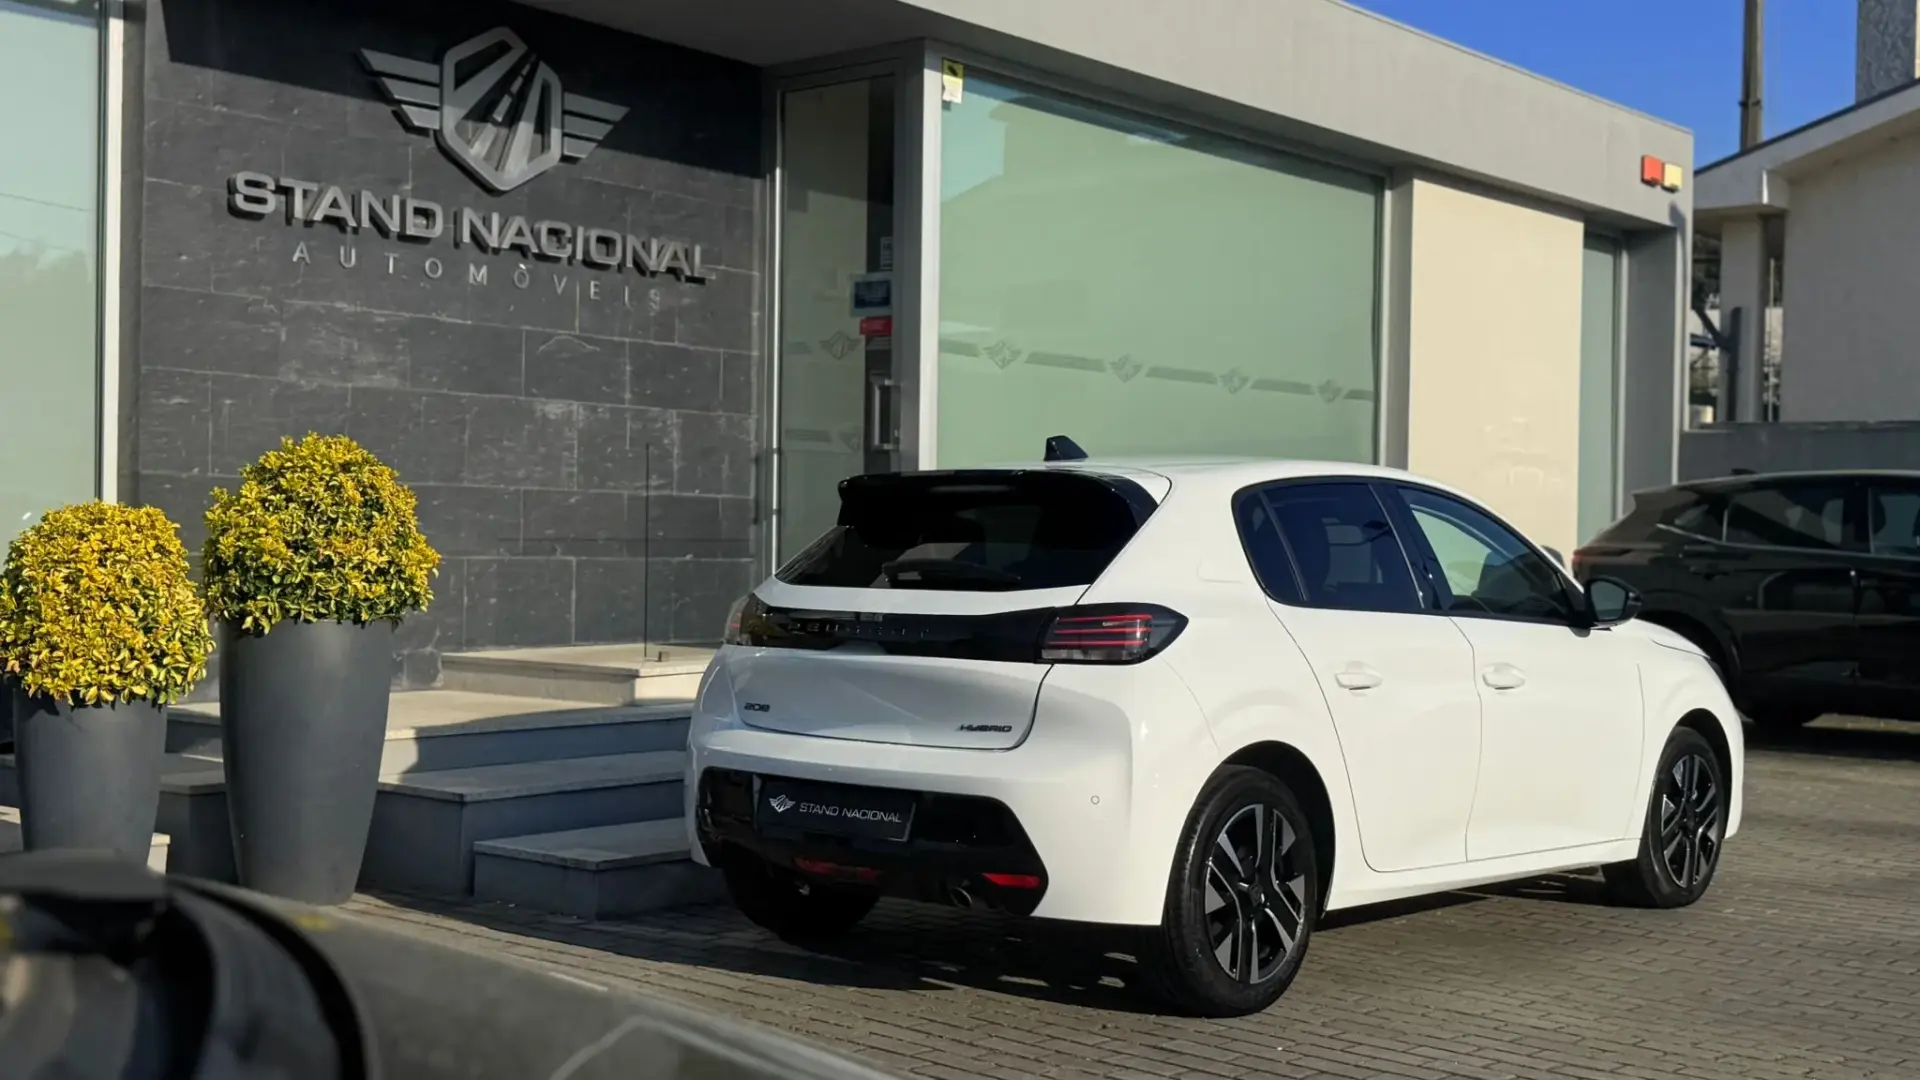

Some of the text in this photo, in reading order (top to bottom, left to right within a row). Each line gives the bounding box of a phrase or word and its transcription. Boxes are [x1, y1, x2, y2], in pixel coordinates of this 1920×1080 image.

[233, 170, 716, 280] STAND NACIONAL
[744, 702, 770, 712] 208
[959, 724, 1012, 733] HYBRID
[799, 802, 902, 823] STAND NACIONAL
